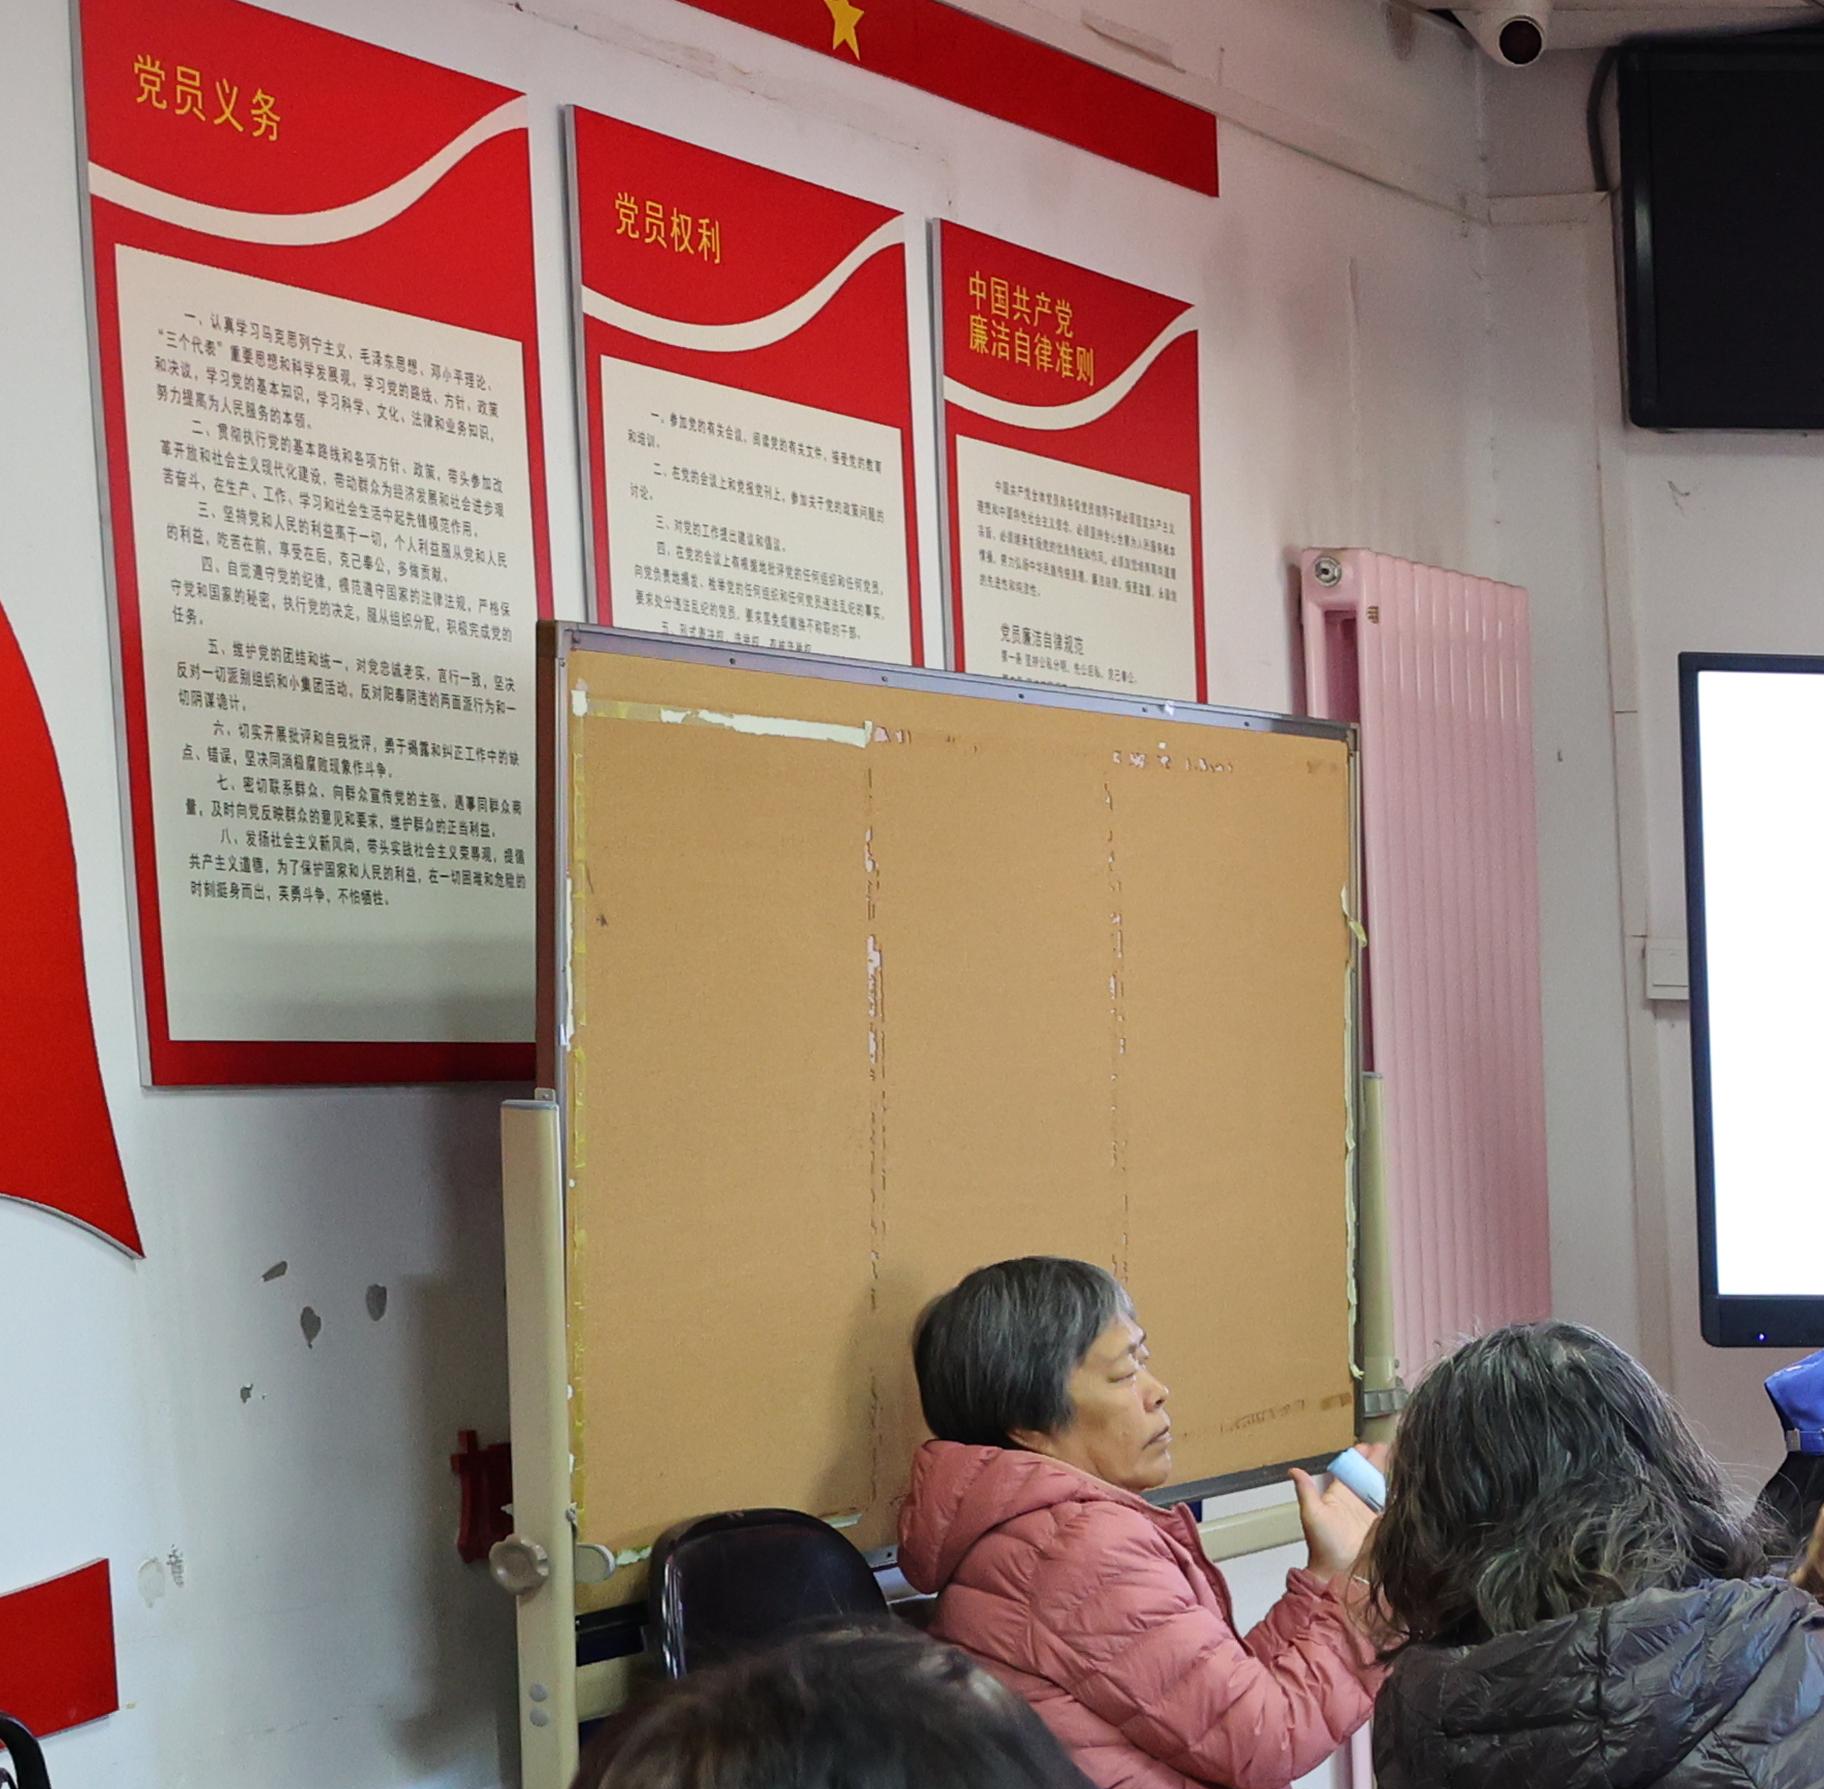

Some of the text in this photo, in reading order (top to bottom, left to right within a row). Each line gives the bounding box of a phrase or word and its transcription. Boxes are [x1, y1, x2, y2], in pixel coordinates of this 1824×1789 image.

[133, 54, 282, 141] 党员义务
[614, 192, 722, 265] 党员权利
[968, 271, 1074, 339] 中国共产党
[968, 314, 1095, 386] 廉洁自律准则
